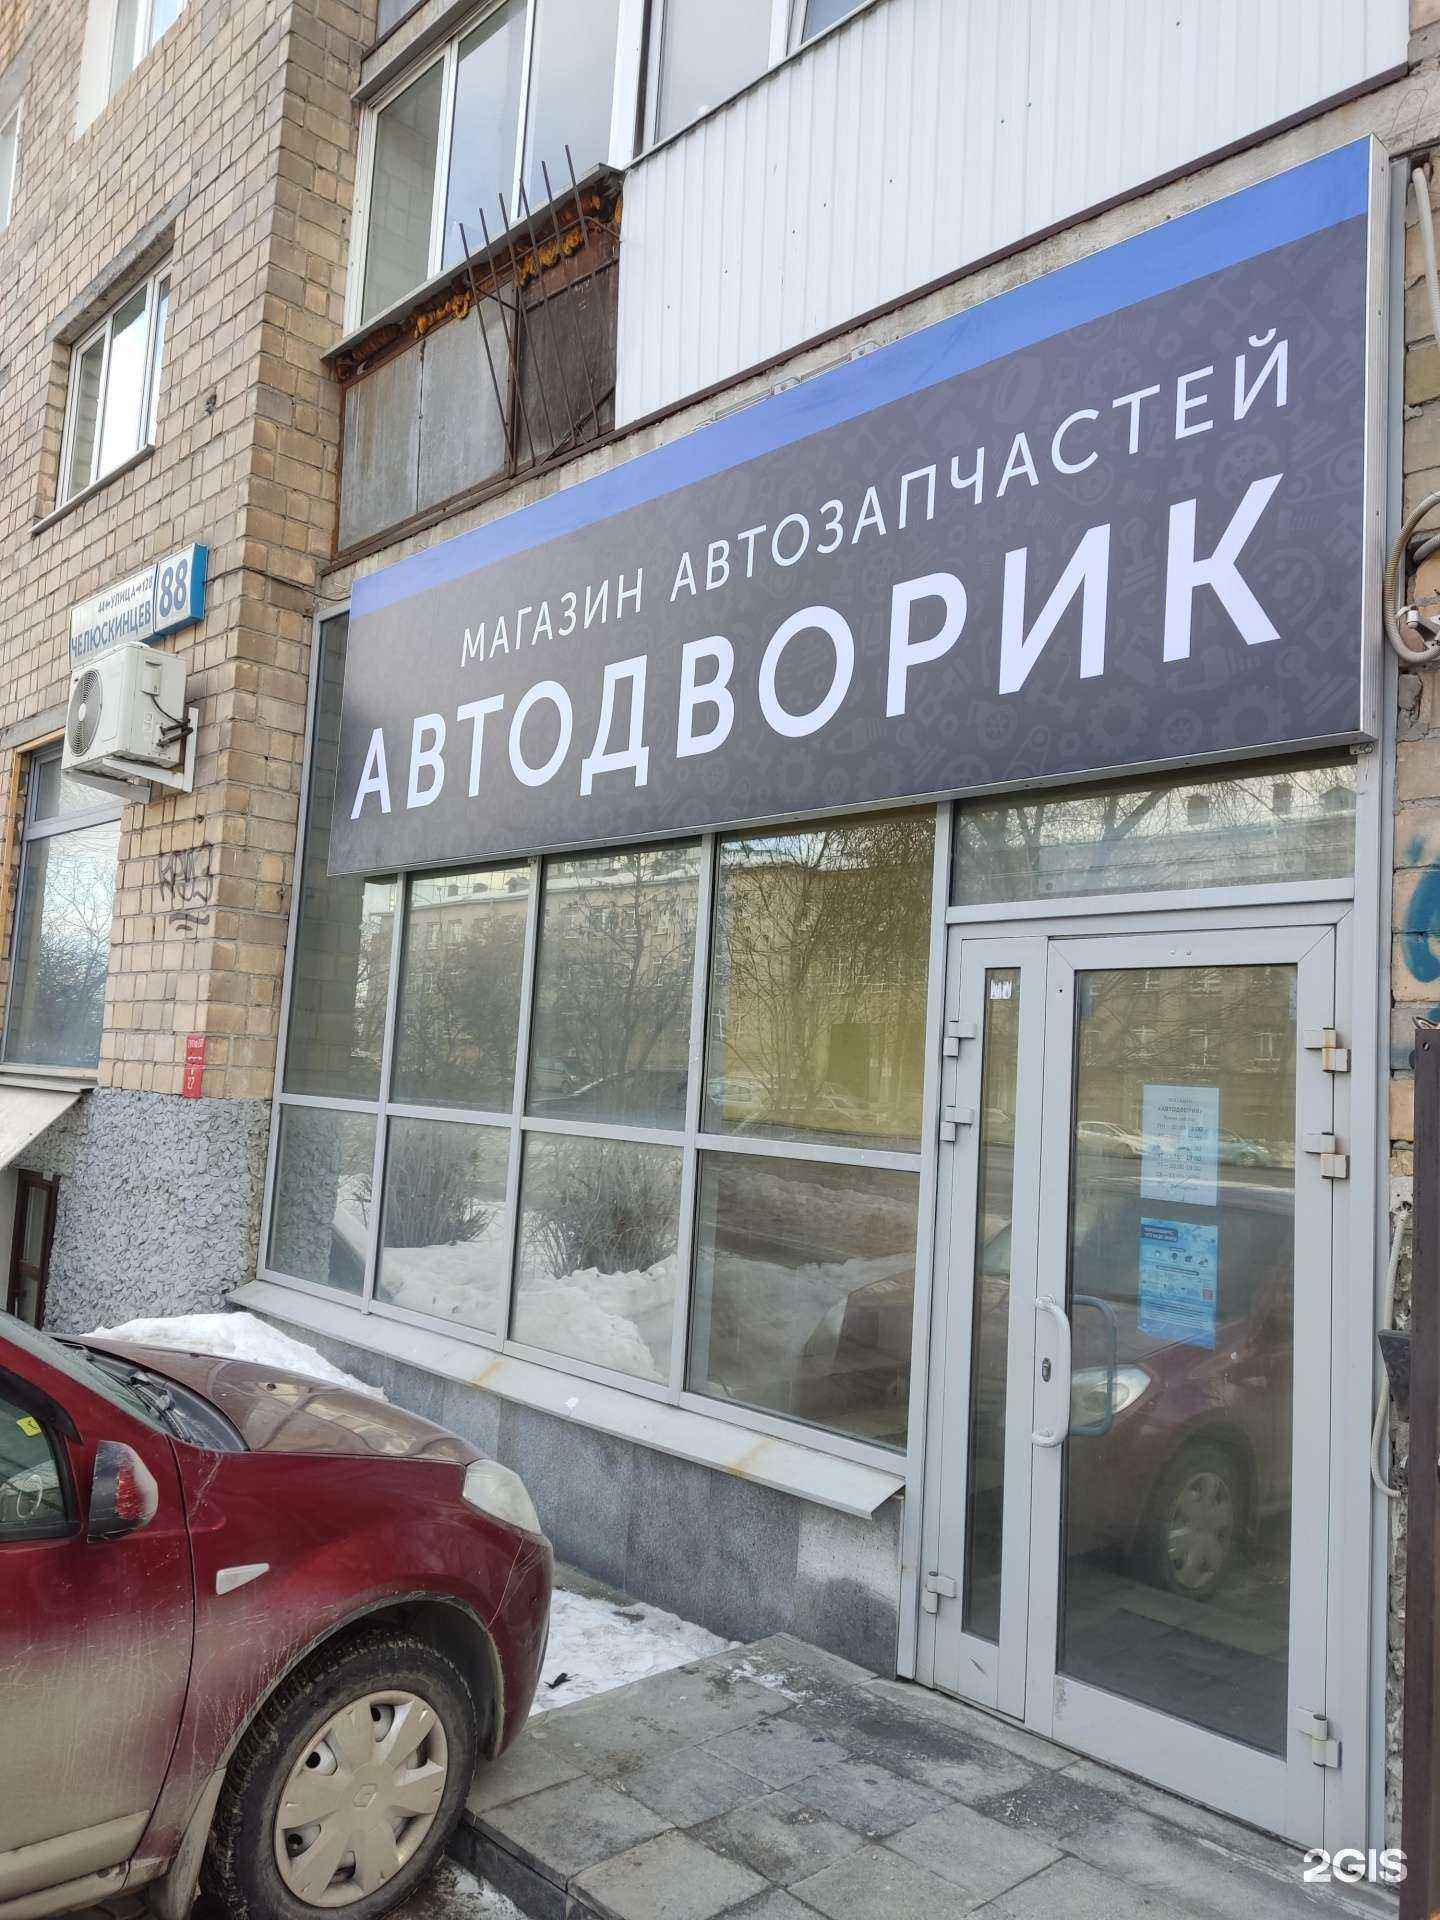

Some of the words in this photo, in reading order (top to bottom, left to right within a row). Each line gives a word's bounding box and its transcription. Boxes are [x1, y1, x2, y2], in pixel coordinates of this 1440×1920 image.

[460, 567, 643, 667] МАГАЗИН
[670, 328, 1288, 602] АВТОЗАПЧАСТЕЙ
[111, 587, 136, 608] УЛИЦА
[159, 558, 188, 618] 88
[71, 600, 151, 658] ЧЕЛЮСКИНЦЕВ
[350, 473, 1284, 820] АВТОДВОРИК
